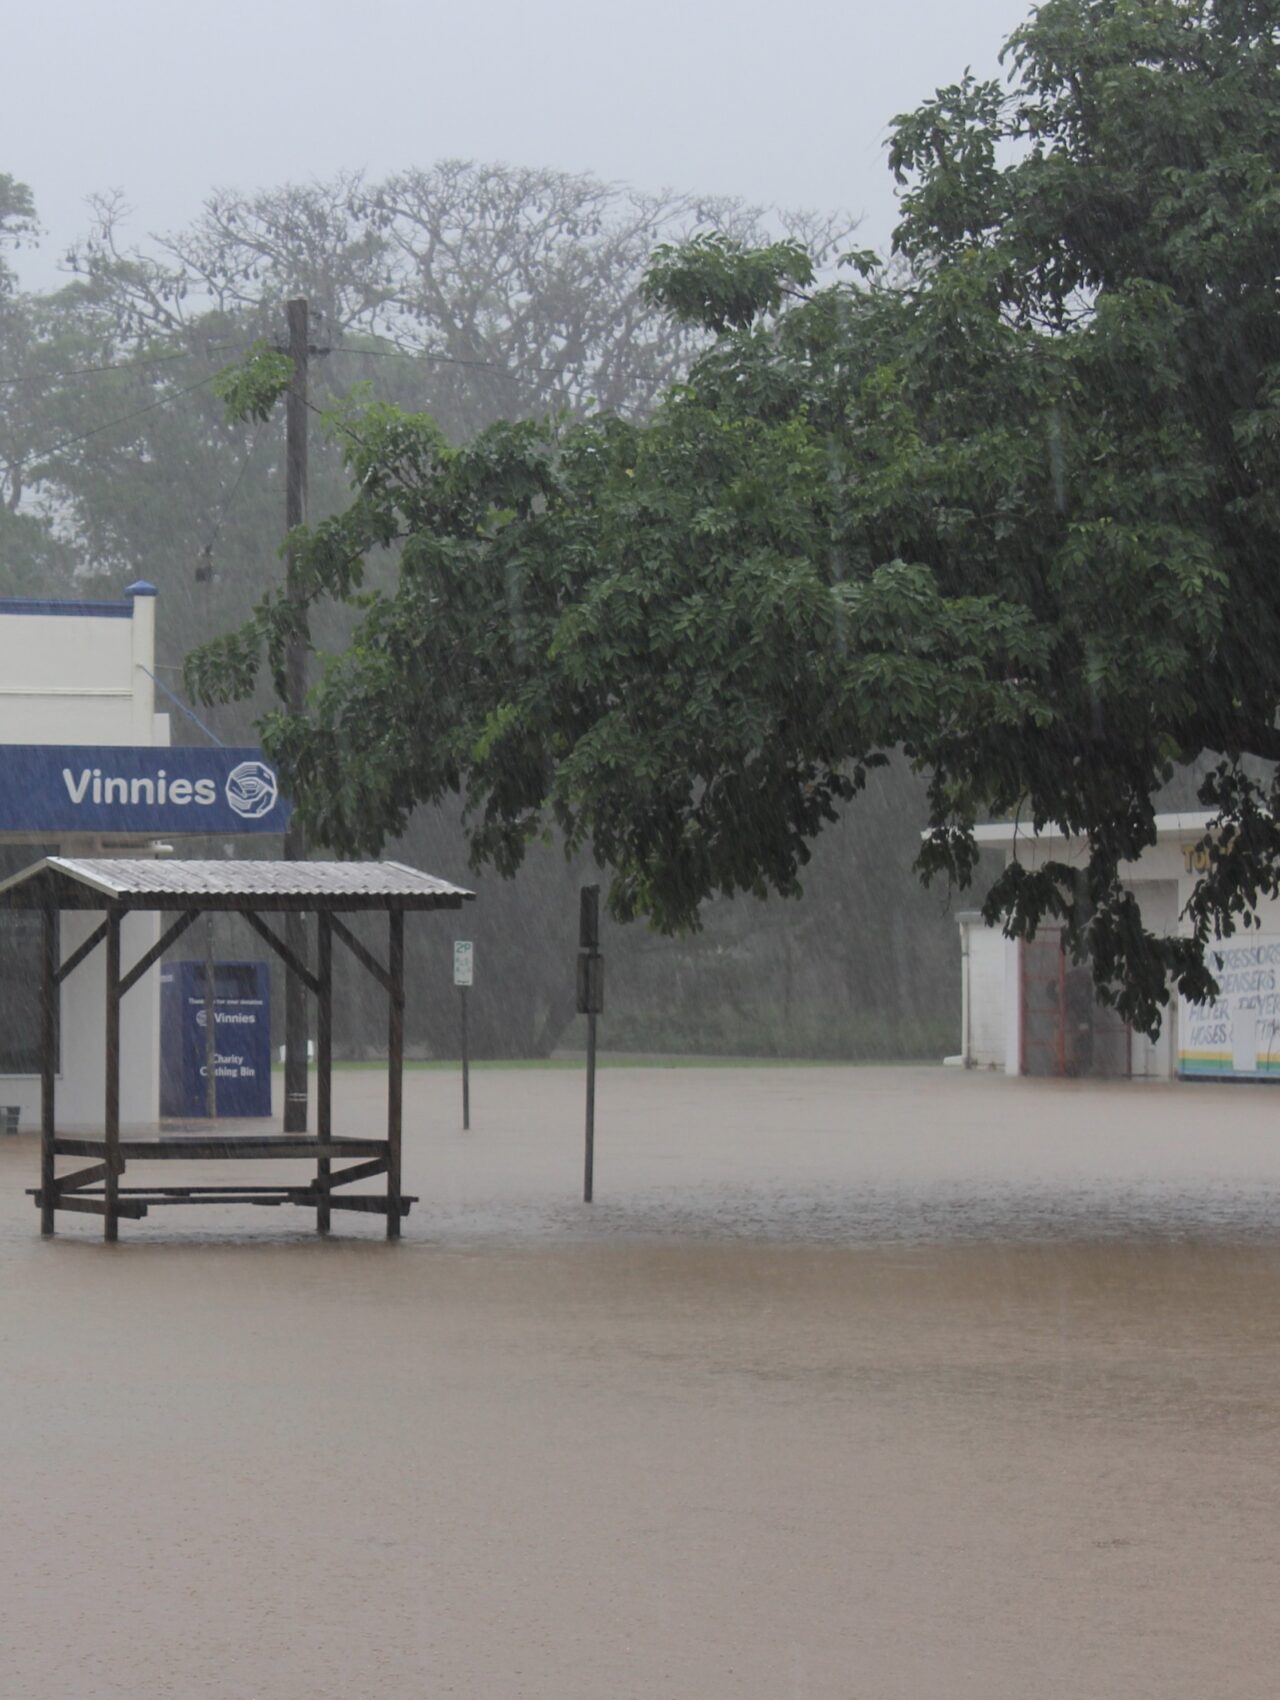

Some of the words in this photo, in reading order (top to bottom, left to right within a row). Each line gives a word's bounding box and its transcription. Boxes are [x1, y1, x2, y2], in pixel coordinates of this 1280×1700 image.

[62, 768, 216, 805] Vinnies
[456, 943, 471, 953] 2P
[1215, 967, 1276, 993] DENSERS
[214, 1012, 256, 1024] Vinnies
[1190, 1022, 1227, 1046] HOSES
[200, 1066, 238, 1078] Cthing
[240, 1066, 256, 1077] Bin
